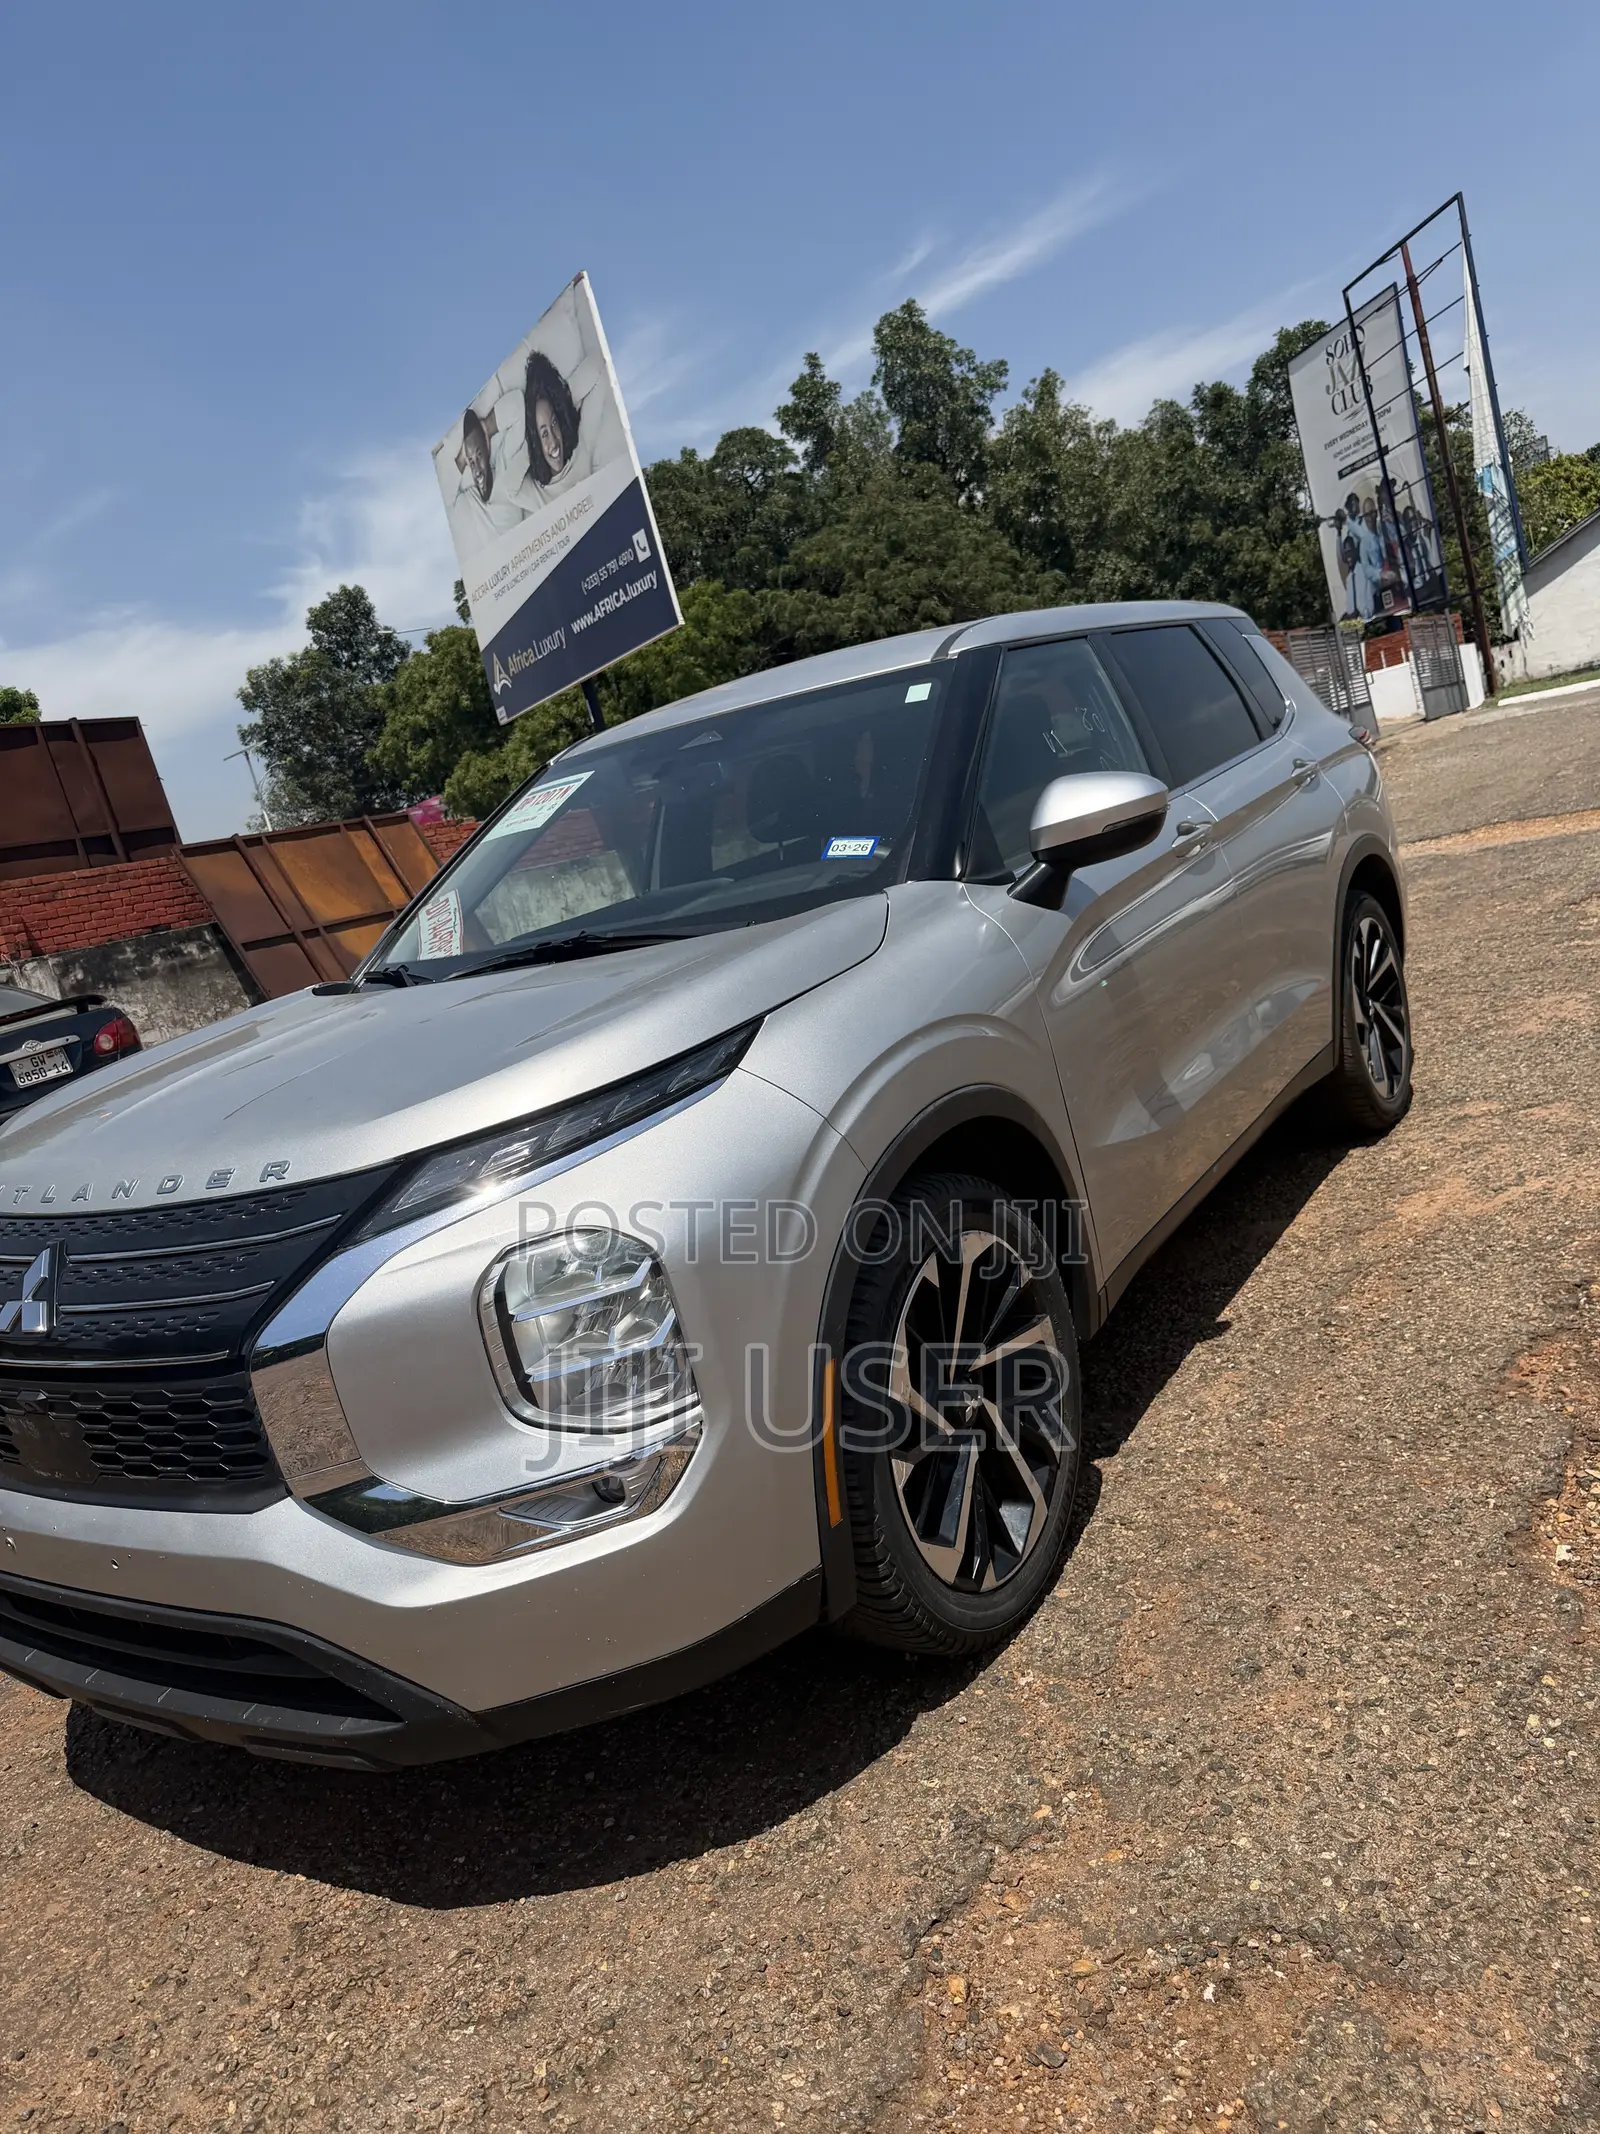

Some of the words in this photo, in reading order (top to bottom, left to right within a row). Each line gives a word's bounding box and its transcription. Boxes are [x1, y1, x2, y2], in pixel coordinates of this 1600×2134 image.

[488, 563, 512, 590] LUXURY
[510, 529, 552, 572] APARTMENTS
[550, 517, 567, 539] AND
[599, 563, 609, 581] 55
[606, 557, 619, 575] 791
[570, 569, 659, 635] www.AFRICA.luxury
[507, 626, 567, 676] Africa.Luxury
[17, 1061, 69, 1084] 6850-14
[30, 1054, 47, 1069] GW
[0, 1159, 291, 1204] TLANDER
